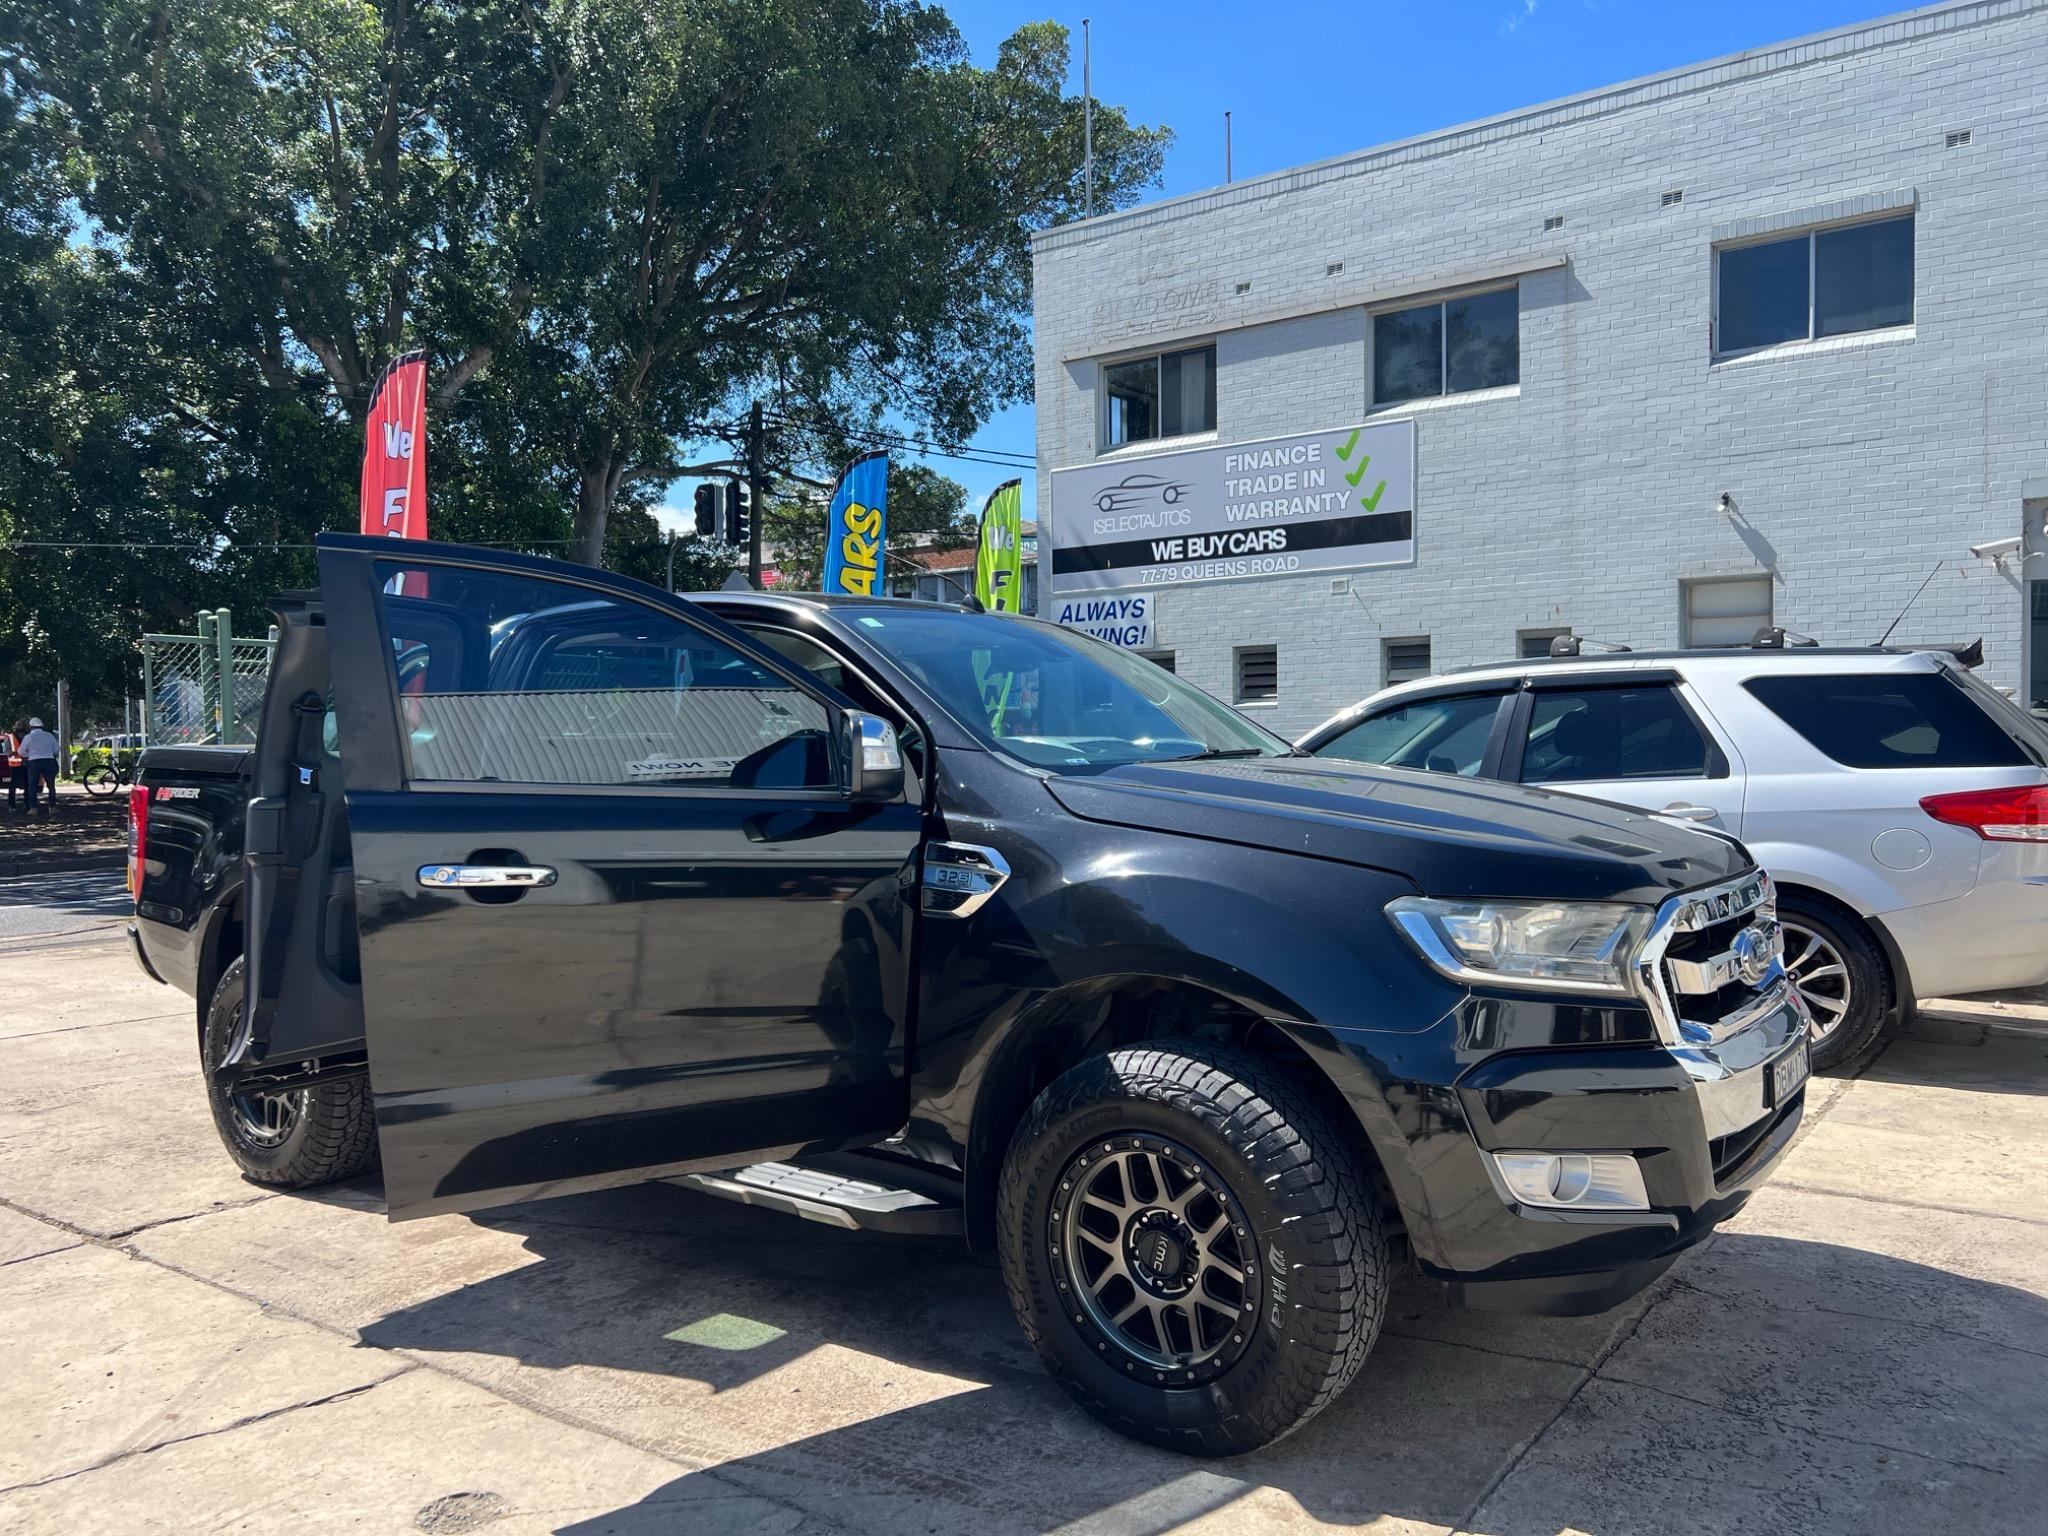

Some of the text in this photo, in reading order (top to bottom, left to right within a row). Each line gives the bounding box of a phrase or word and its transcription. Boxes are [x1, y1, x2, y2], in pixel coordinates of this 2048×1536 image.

[1224, 443, 1322, 474] FINANCE
[1224, 467, 1326, 499] TRADE IN
[1224, 490, 1352, 523] WARRANTY
[1151, 528, 1287, 562] WE BUY CARS
[1140, 555, 1300, 583] 77-79 QUEENS ROAD
[1059, 598, 1146, 624] ALWAYS
